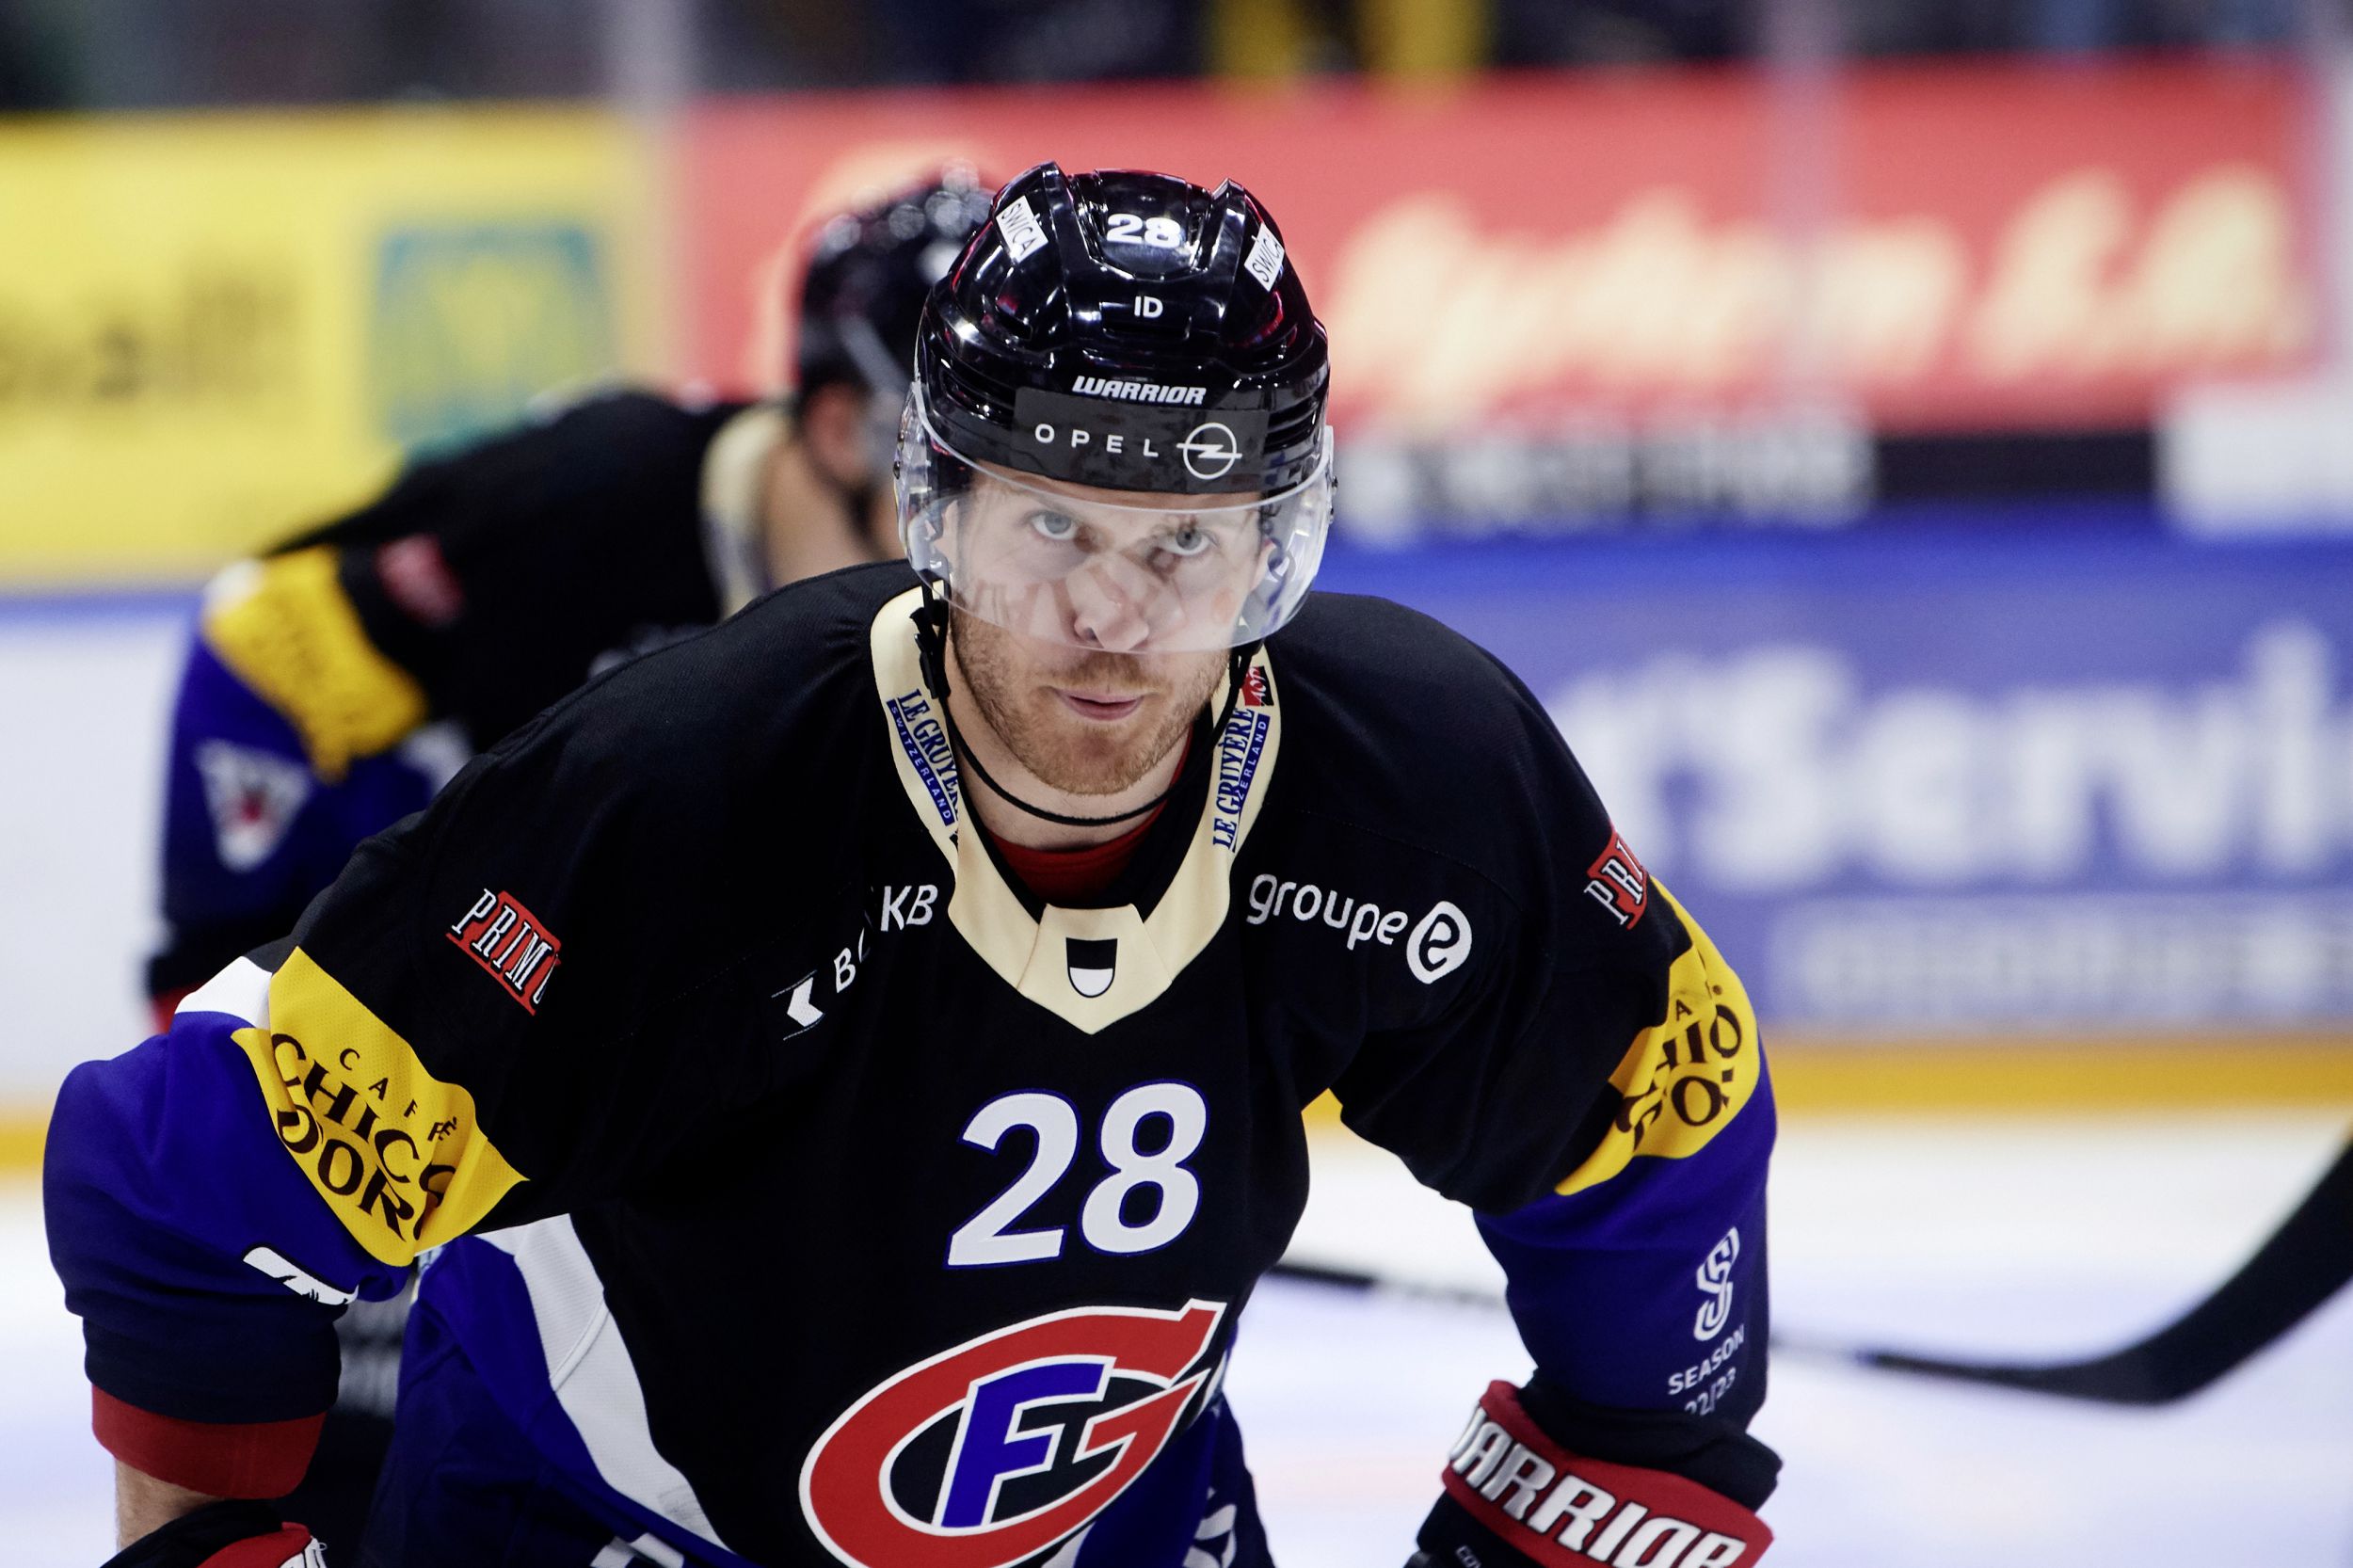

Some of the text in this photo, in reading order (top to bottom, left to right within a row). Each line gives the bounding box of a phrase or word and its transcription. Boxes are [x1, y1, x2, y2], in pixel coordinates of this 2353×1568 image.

[1000, 202, 1038, 257] SWICA
[1106, 213, 1181, 248] 28
[1133, 296, 1163, 318] ID
[1071, 375, 1207, 406] WARRIOR
[1035, 424, 1160, 458] OPEL
[897, 688, 931, 723] LE
[890, 705, 952, 820] SWITZERLAND
[1212, 817, 1238, 851] LE
[1246, 872, 1409, 951] groupe
[945, 1080, 1209, 1269] 28
[1667, 1322, 1746, 1396] SEASON
[1449, 1406, 1748, 1568] ARRIOR
